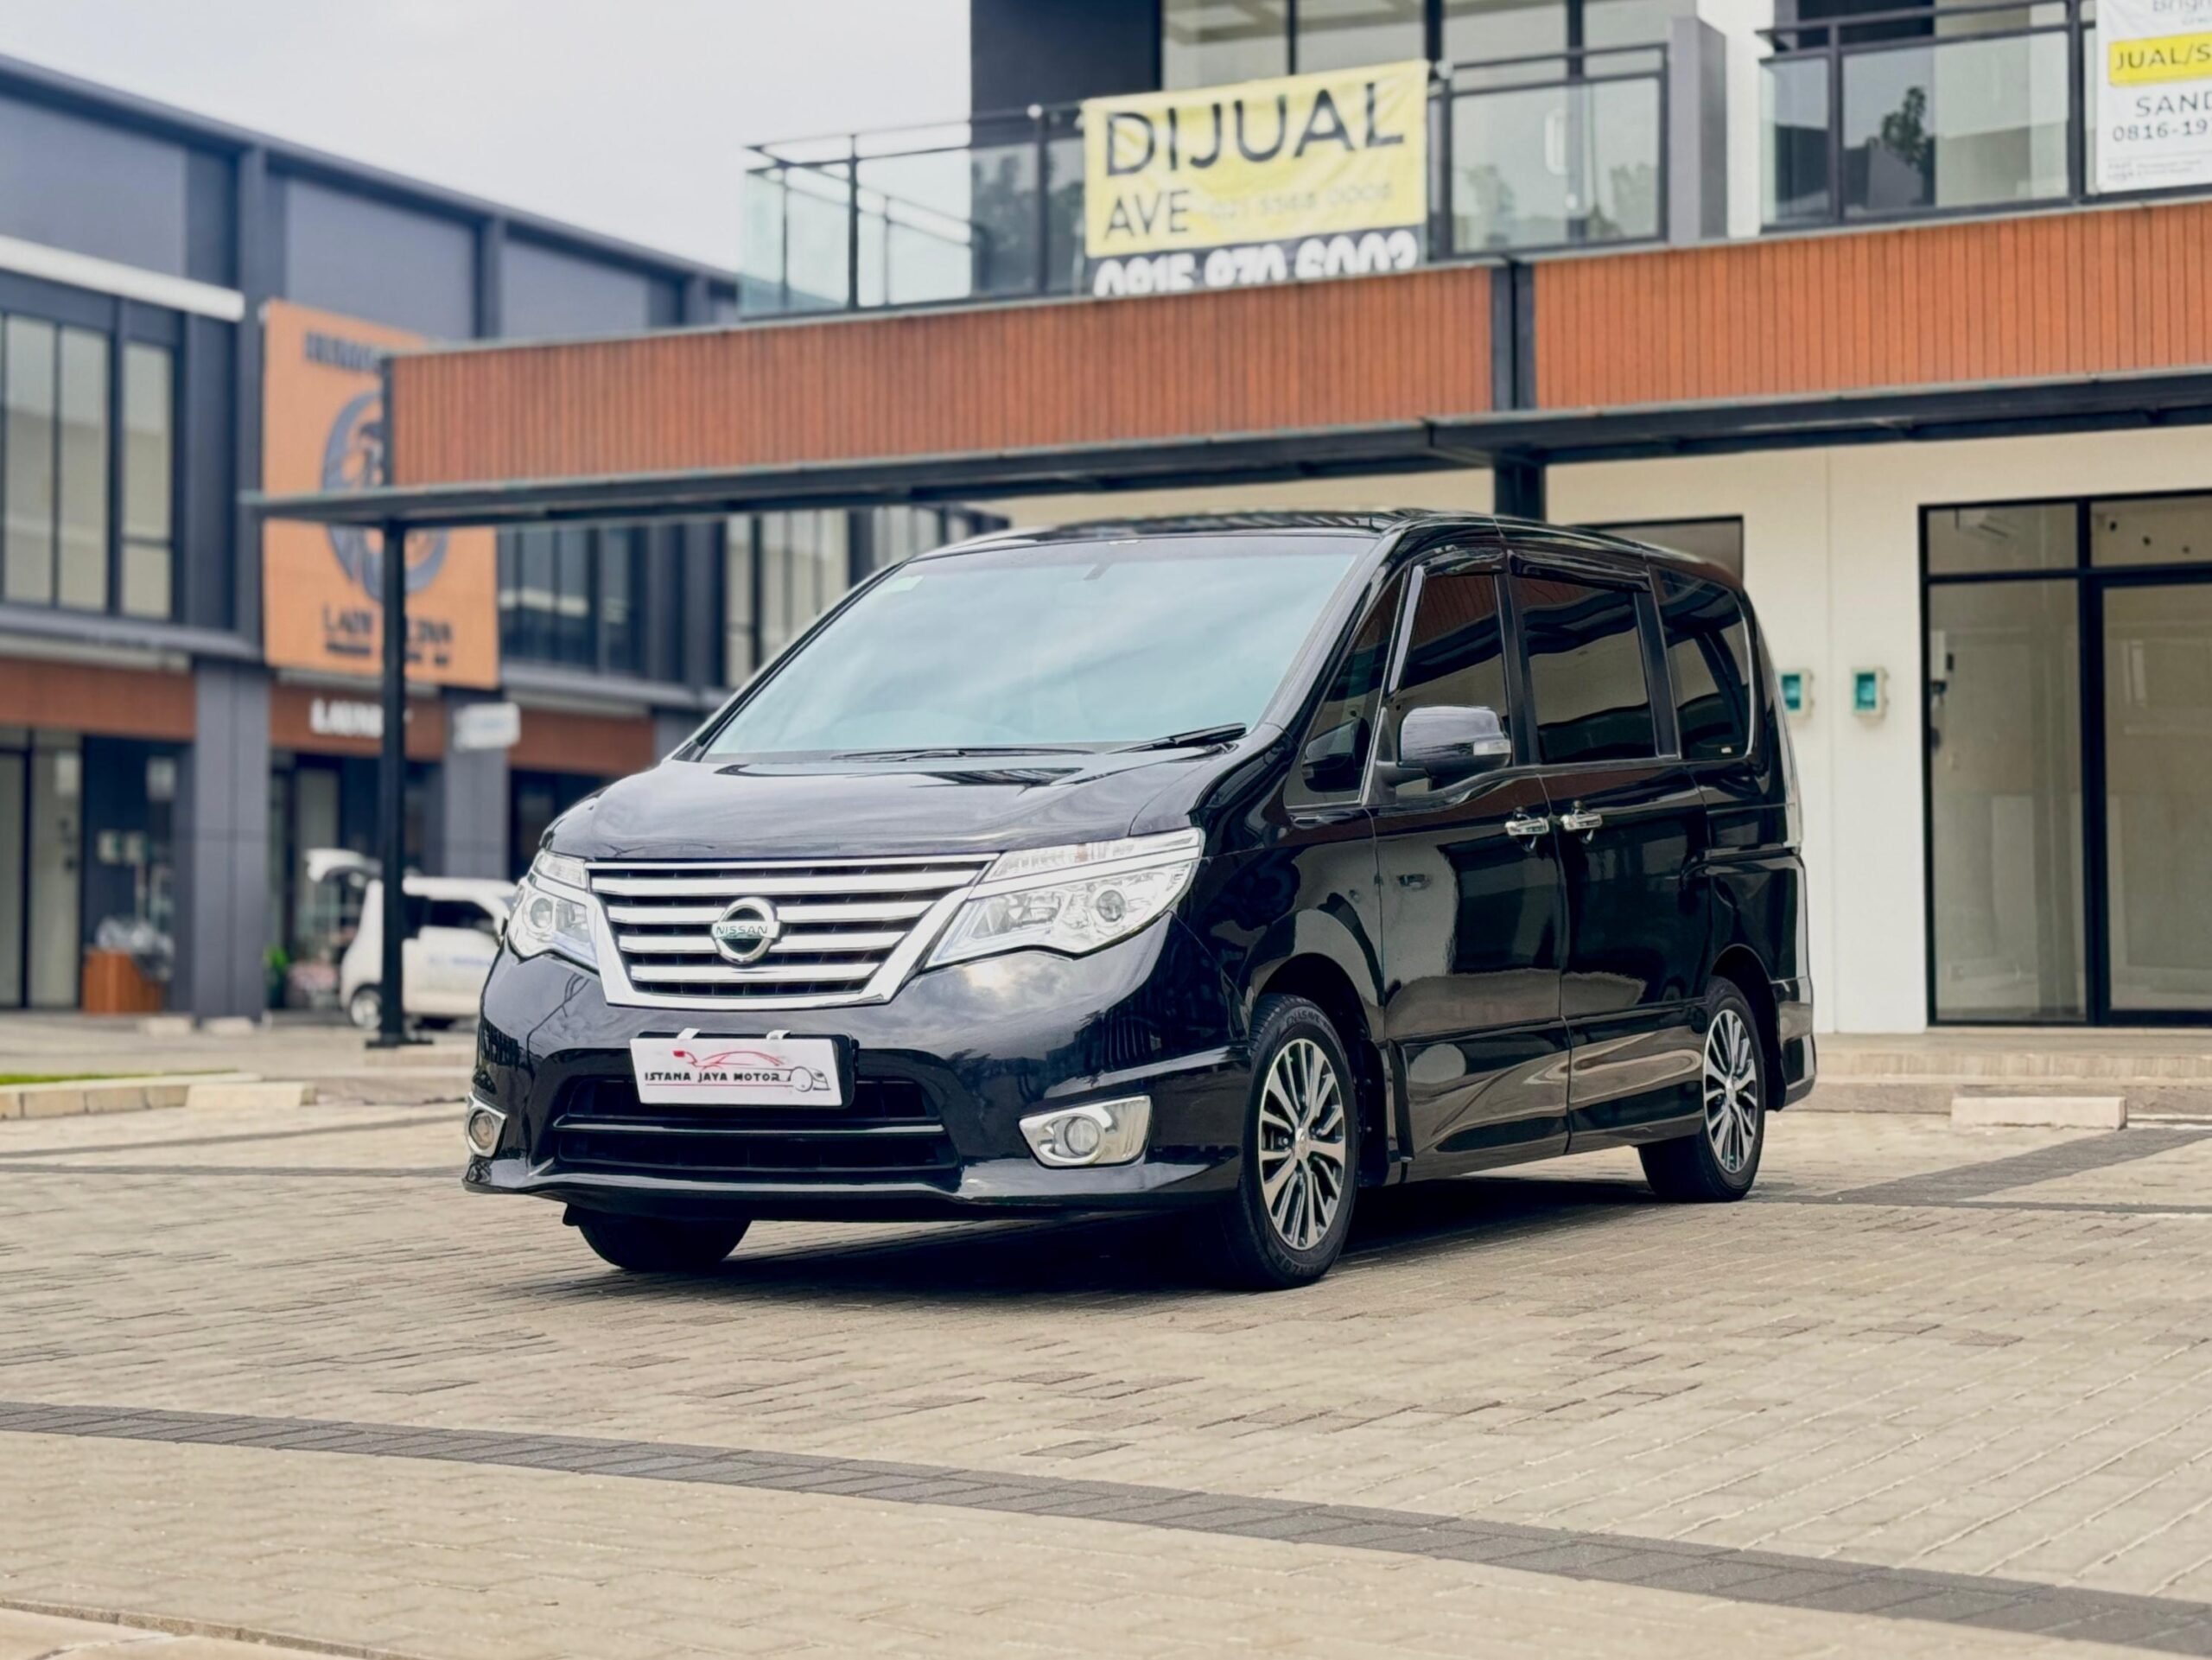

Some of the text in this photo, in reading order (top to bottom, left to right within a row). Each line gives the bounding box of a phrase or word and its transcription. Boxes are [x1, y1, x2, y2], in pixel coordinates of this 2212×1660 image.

[1107, 82, 1404, 177] DIJUAL
[2113, 119, 2212, 142] 0816-19
[1104, 189, 1189, 241] AVE
[716, 925, 768, 935] NISSAN
[645, 1072, 780, 1083] ISTANA JAYA MOTOR
